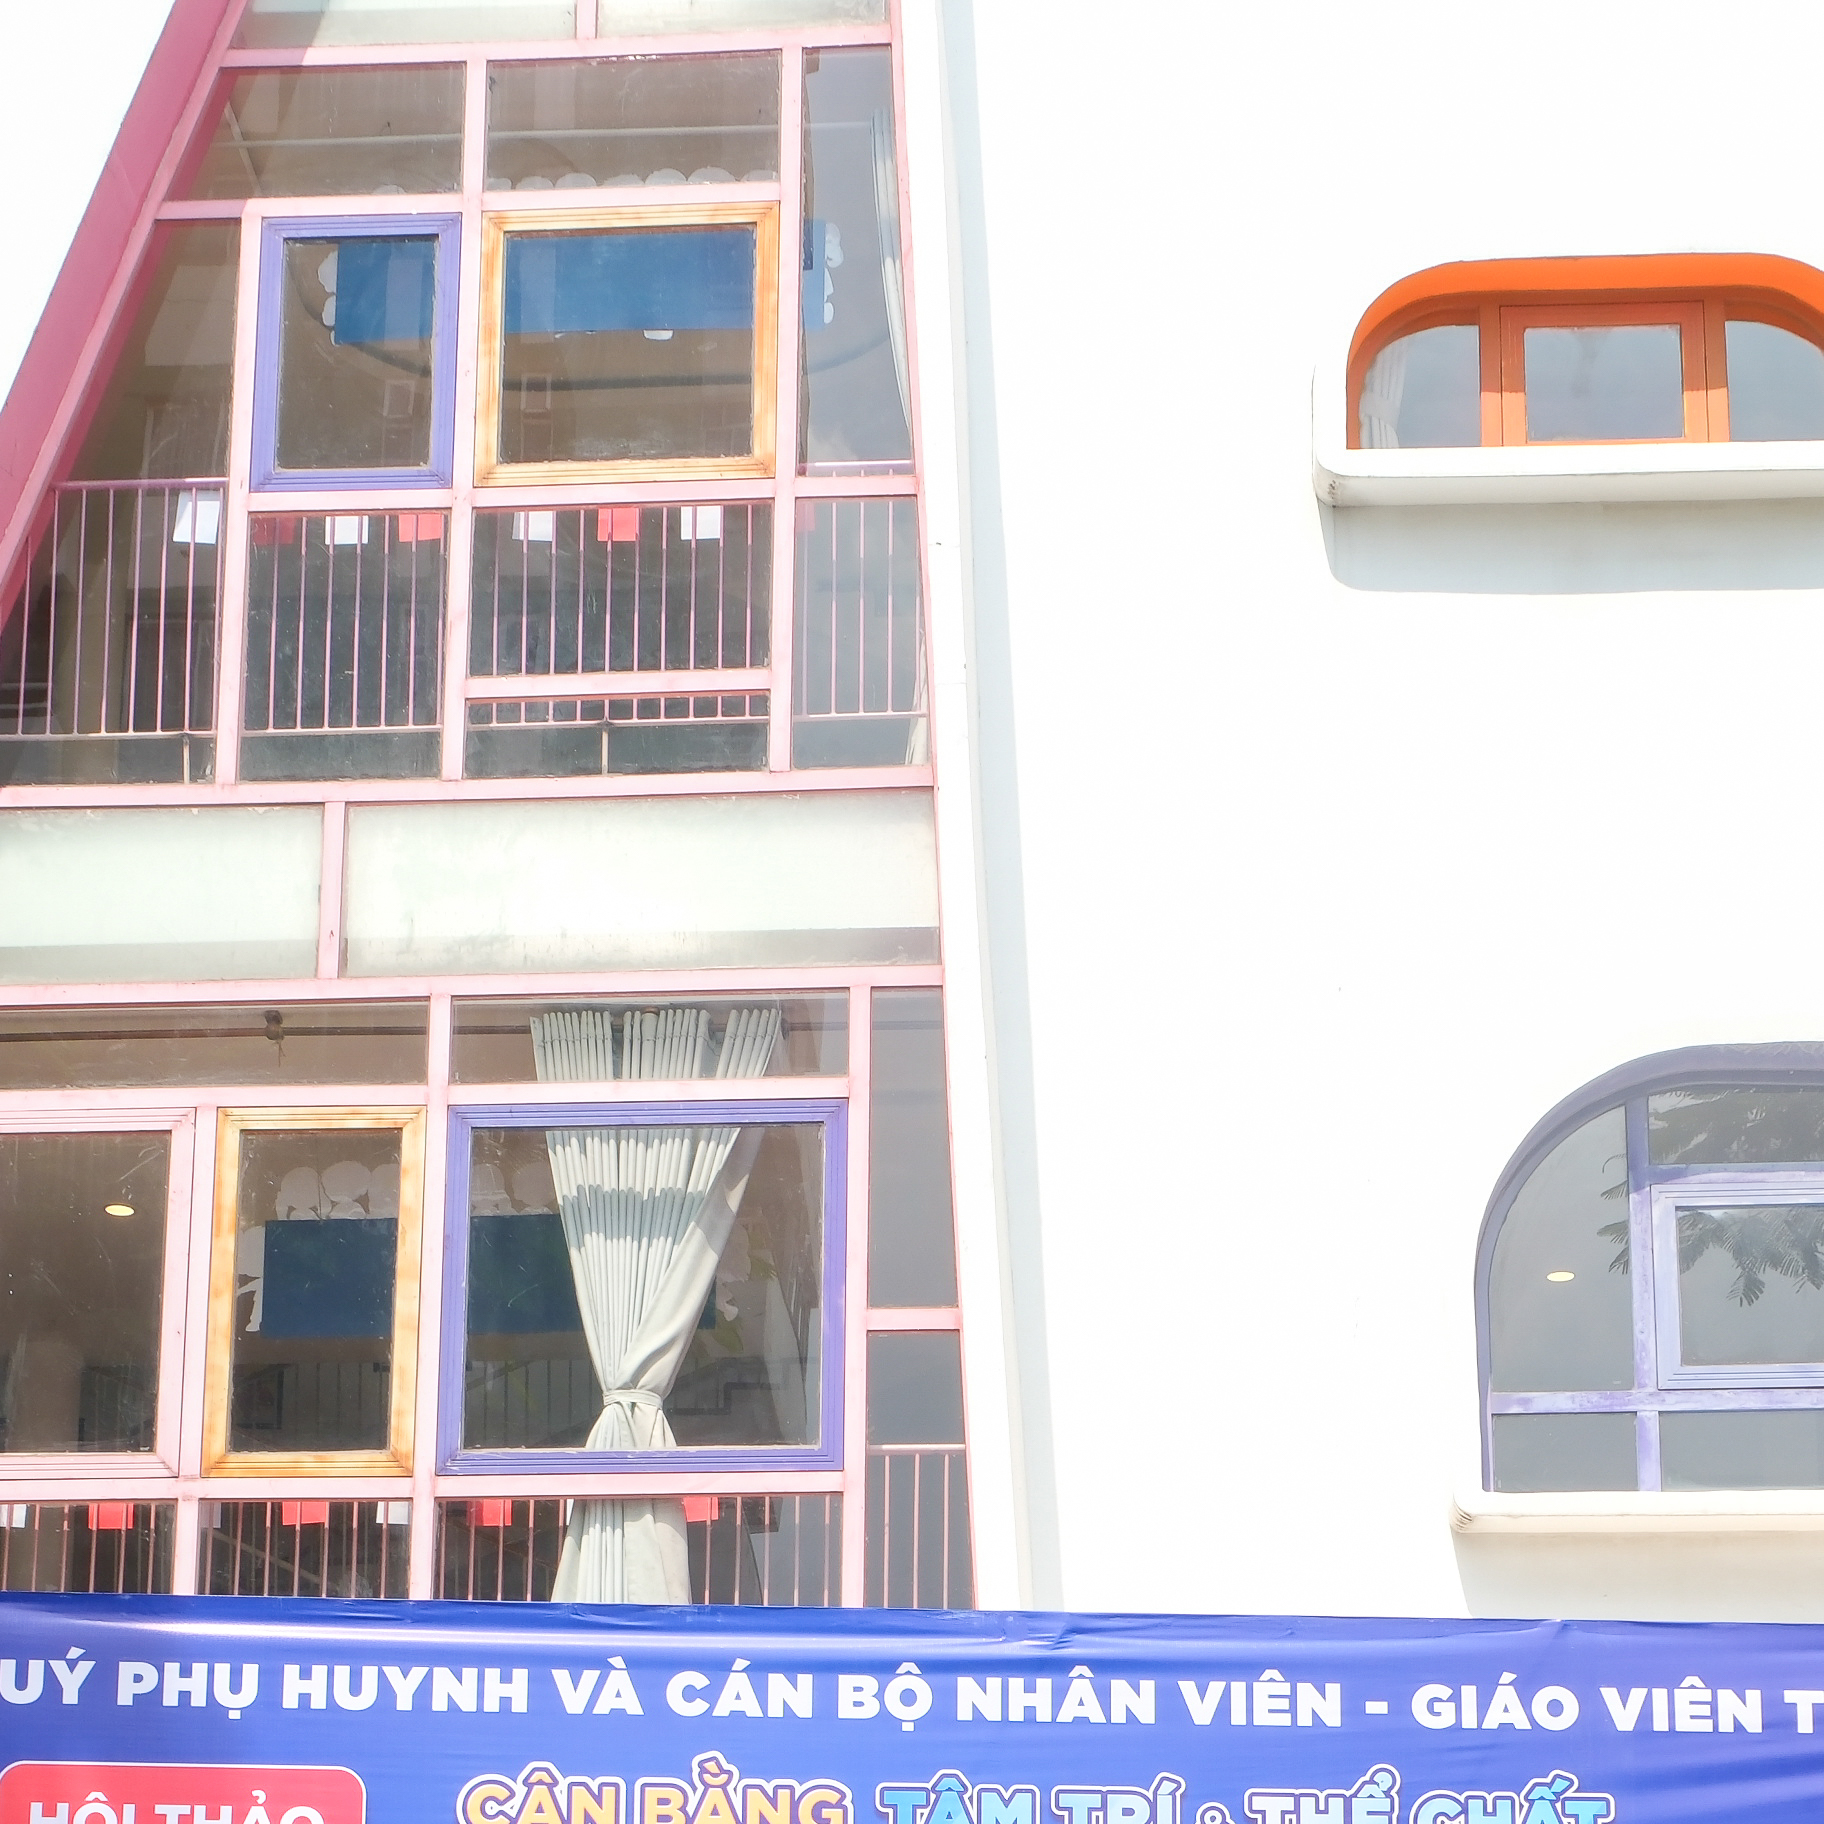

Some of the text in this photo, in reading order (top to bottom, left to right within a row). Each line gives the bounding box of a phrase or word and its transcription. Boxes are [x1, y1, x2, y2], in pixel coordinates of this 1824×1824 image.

[117, 1661, 259, 1720] PHỤ
[281, 1663, 530, 1715] HUYNH
[551, 1655, 644, 1717] VÀ
[665, 1658, 814, 1720] CÁN
[837, 1662, 933, 1733] BỘ
[956, 1665, 1156, 1727] NHÂN
[1178, 1669, 1342, 1728] VIÊN
[1365, 1700, 1389, 1716] -
[1411, 1672, 1580, 1731] GIÁO
[1599, 1675, 1763, 1733] VIÊN
